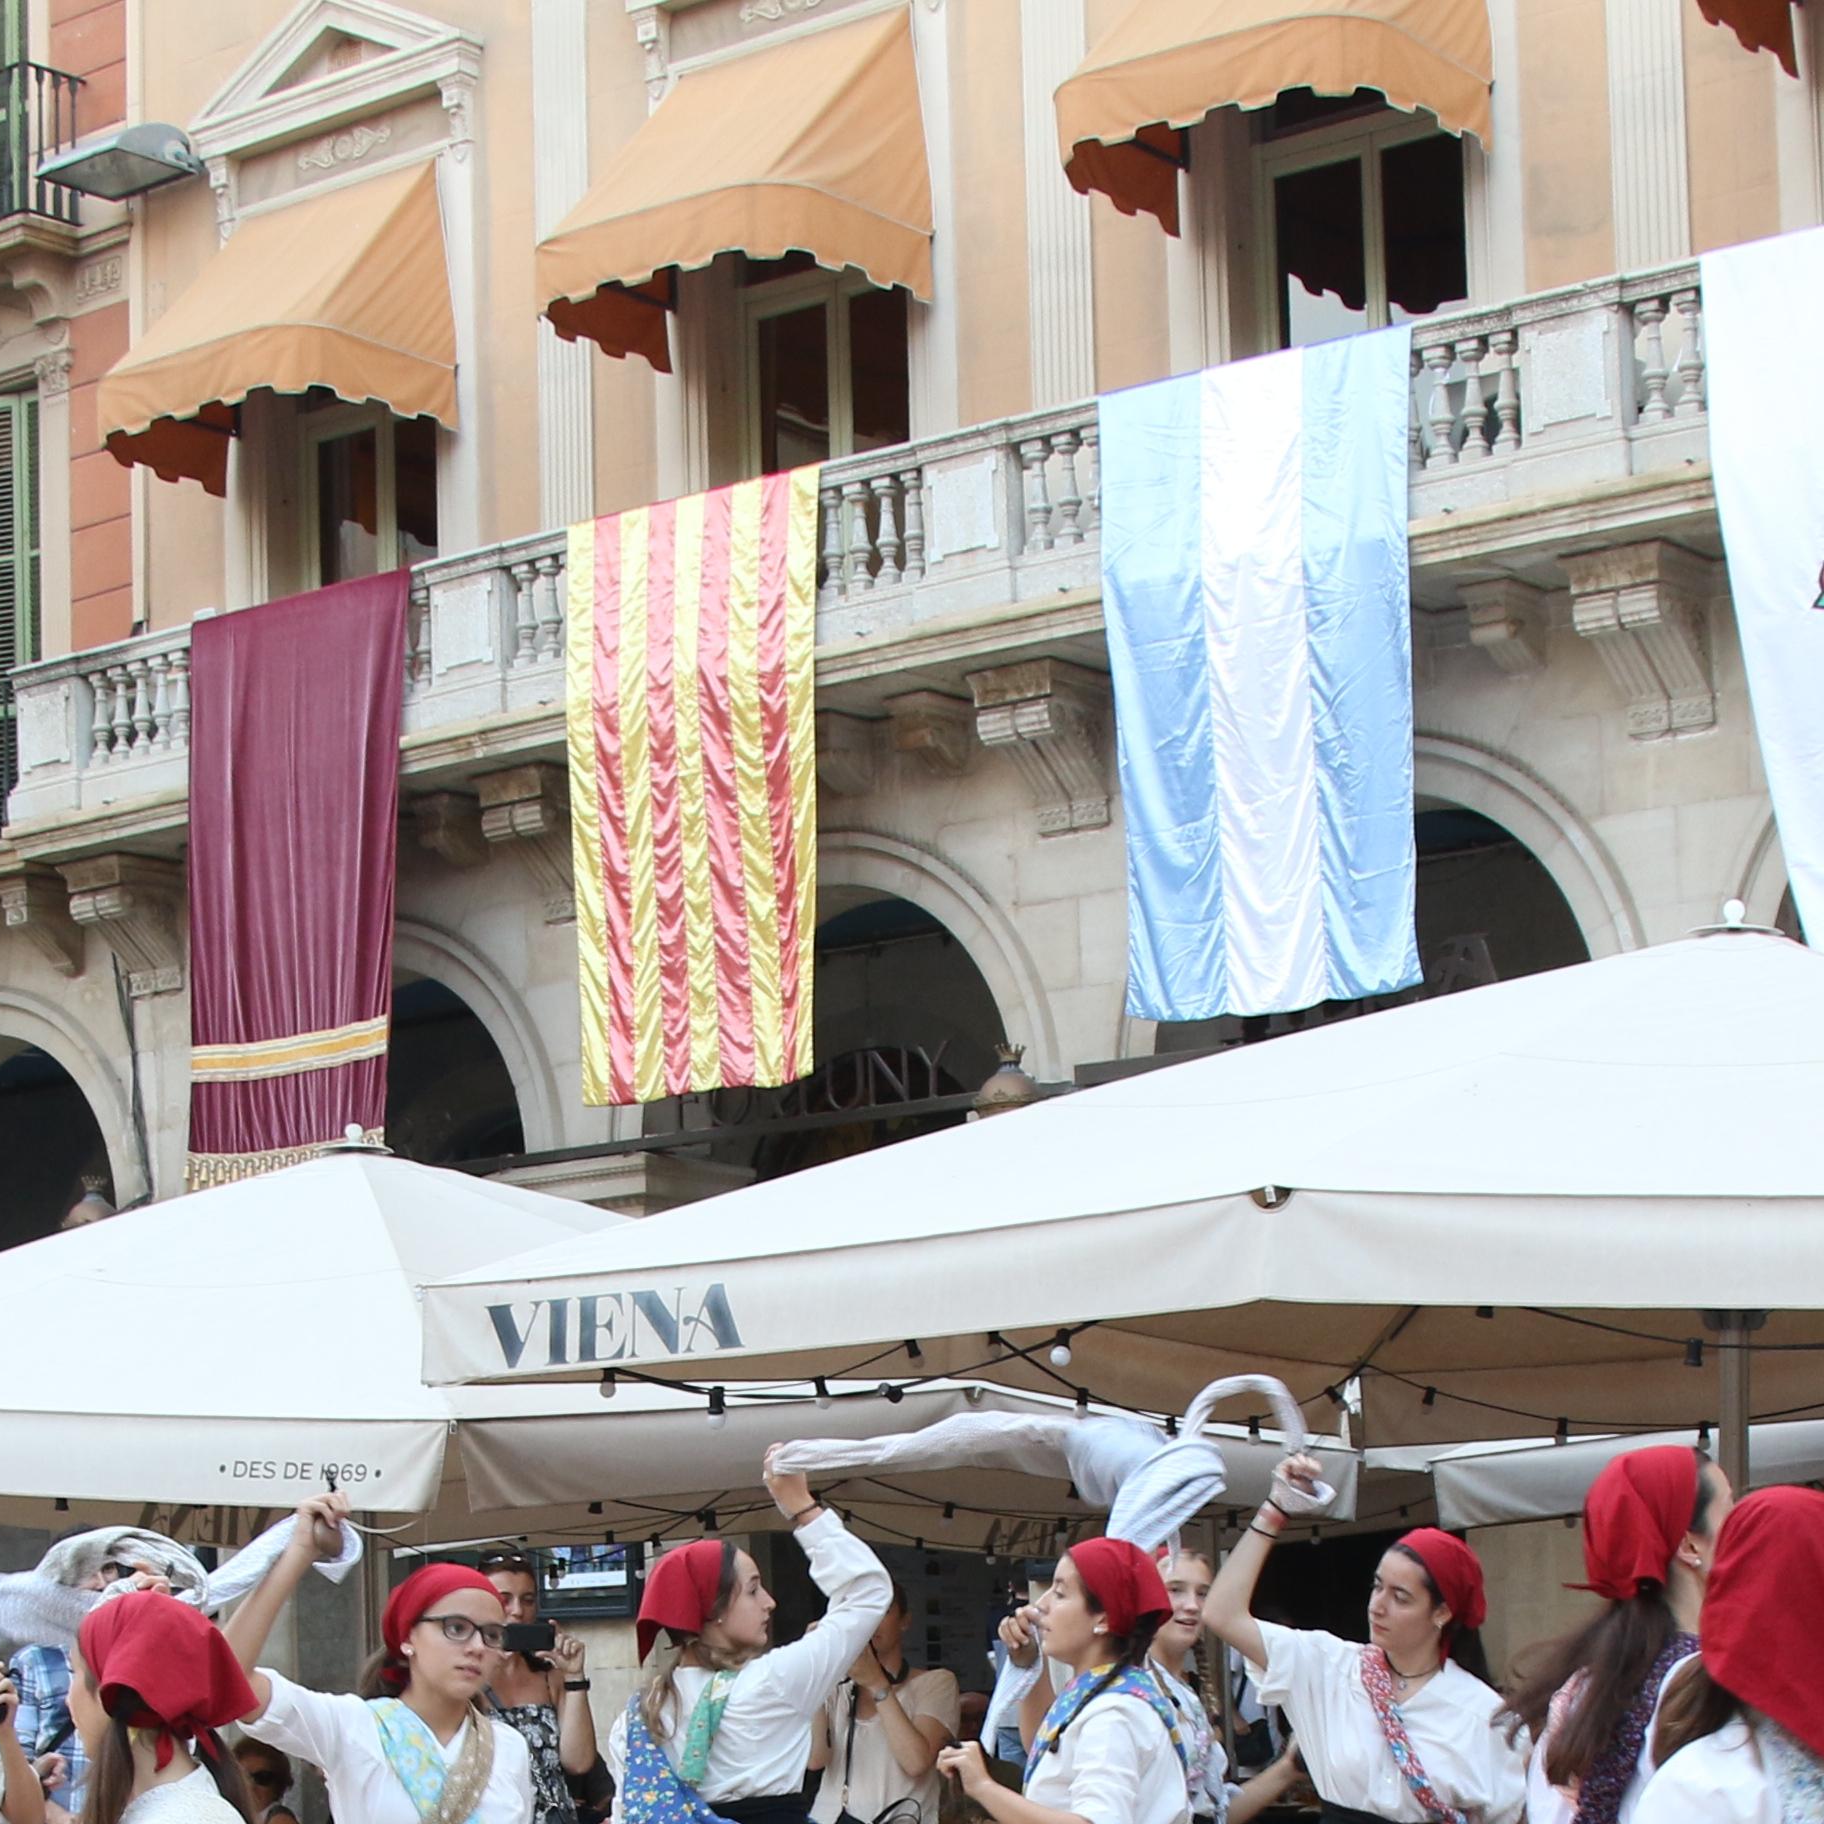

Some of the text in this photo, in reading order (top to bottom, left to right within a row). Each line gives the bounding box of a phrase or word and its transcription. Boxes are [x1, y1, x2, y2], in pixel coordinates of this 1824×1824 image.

[485, 1283, 746, 1369] VIENA
[232, 1460, 277, 1479] DES
[283, 1461, 314, 1480] DE
